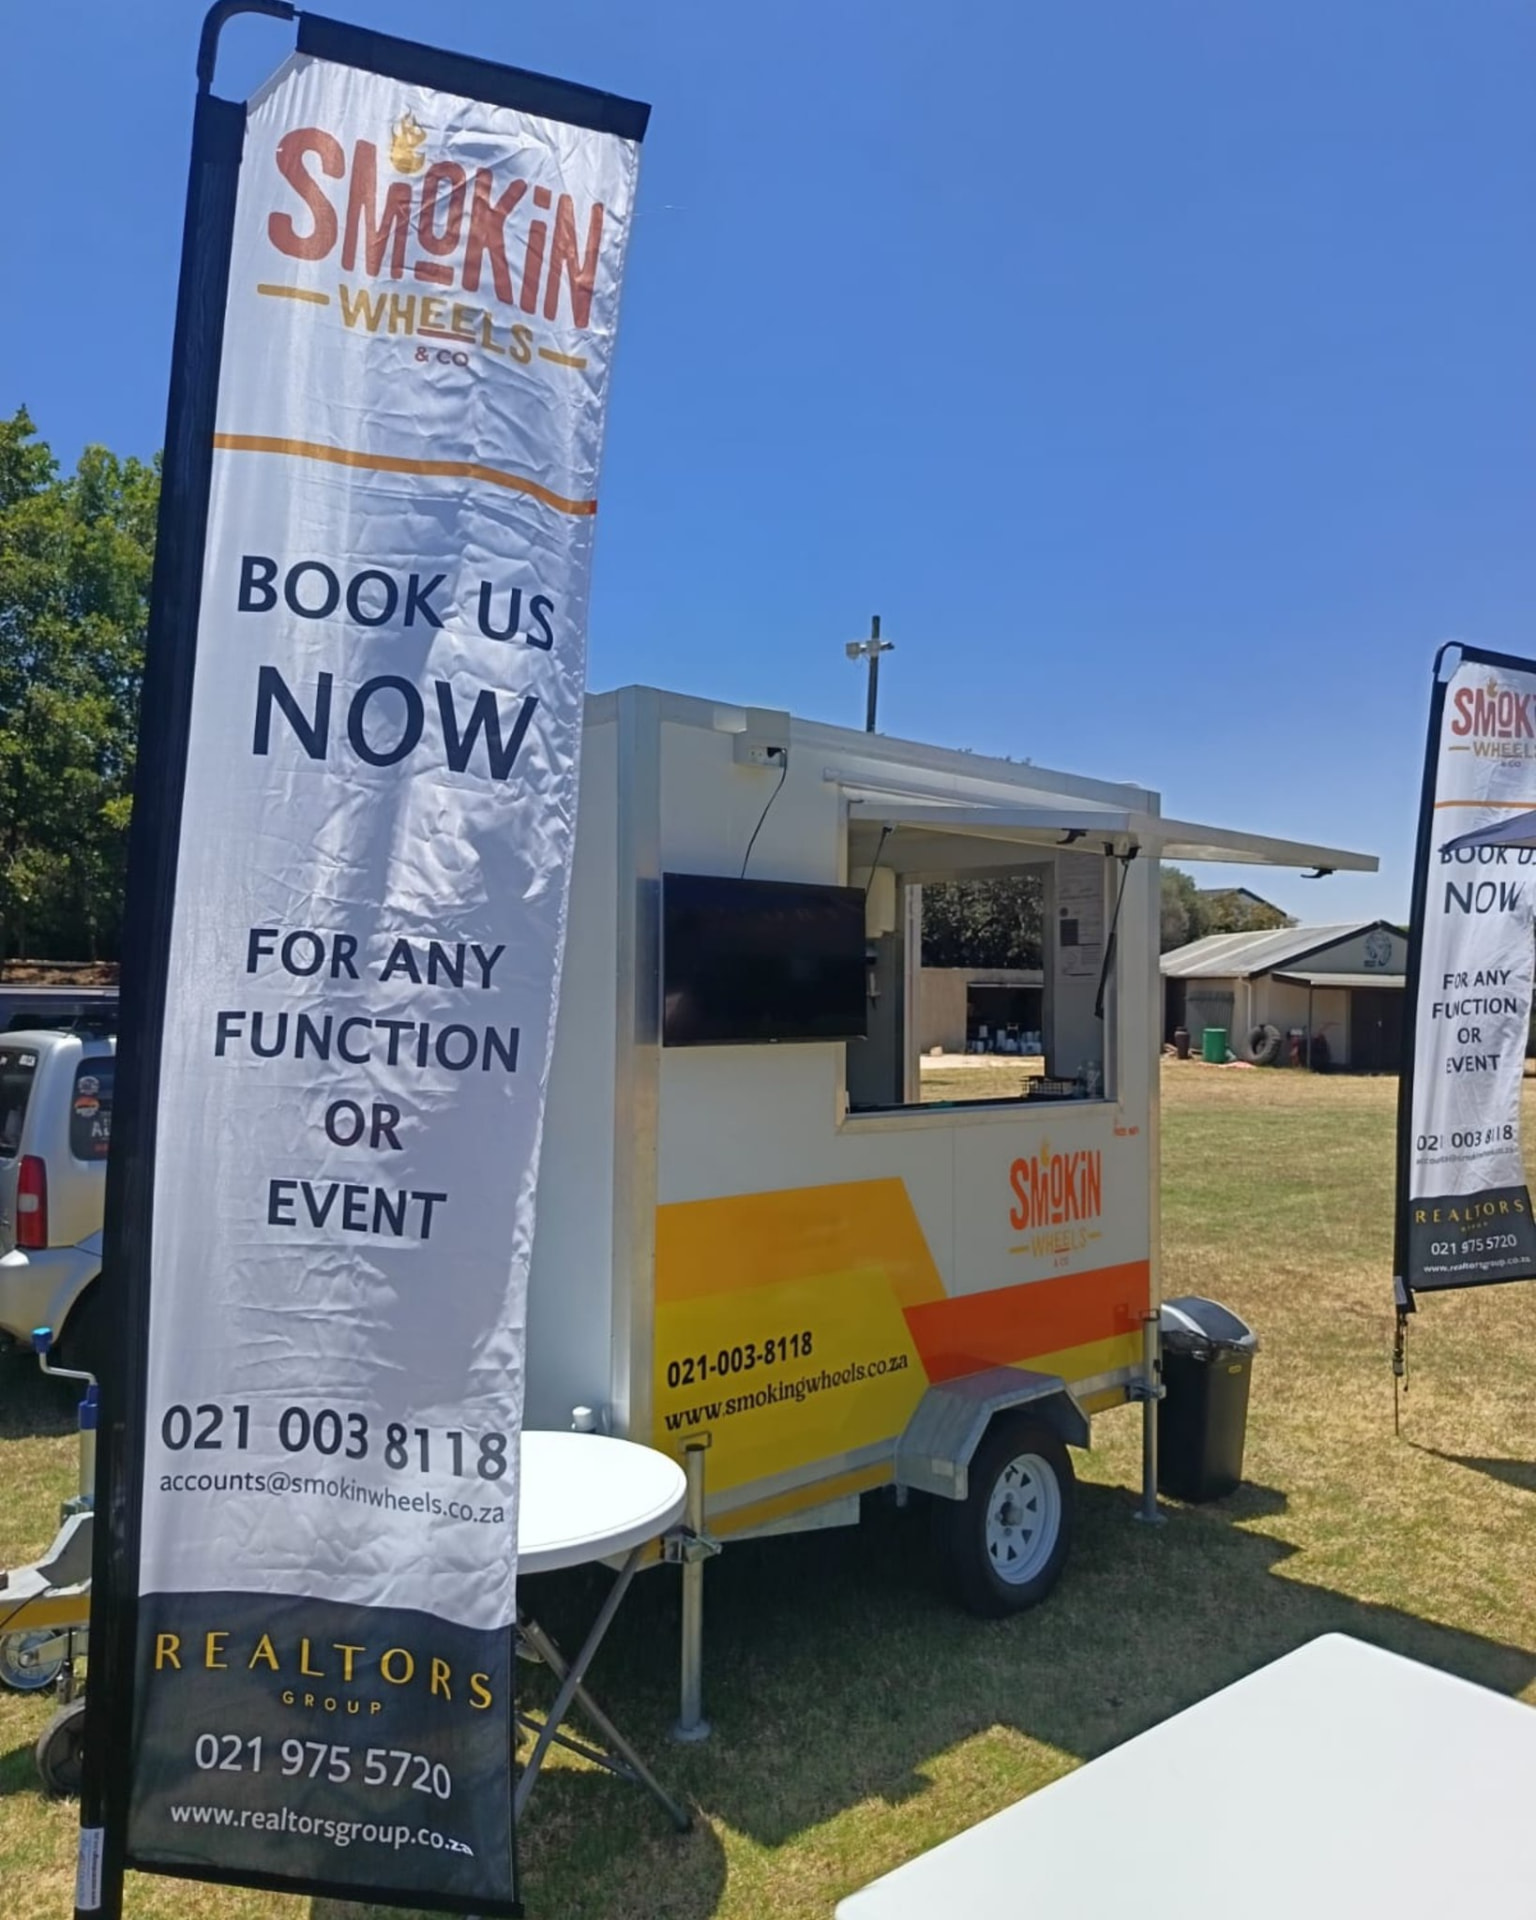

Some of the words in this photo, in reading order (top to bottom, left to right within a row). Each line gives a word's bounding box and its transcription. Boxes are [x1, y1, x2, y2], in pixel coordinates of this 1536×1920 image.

[339, 284, 533, 365] WHEELS
[415, 345, 429, 362] &
[436, 349, 469, 367] CO
[237, 555, 447, 629] BOOK
[477, 580, 555, 651] US
[252, 665, 539, 781] NOW
[1444, 881, 1526, 914] NOW
[246, 928, 360, 980] FOR
[378, 938, 506, 989] ANY
[1474, 969, 1511, 987] ANY
[214, 1011, 520, 1073] FUNCTION
[1457, 1027, 1482, 1044] OR
[1446, 1054, 1501, 1074] EVENT
[325, 1099, 403, 1150] OR
[1451, 1131, 1482, 1148] 003
[267, 1179, 448, 1239] EVENT
[1414, 1199, 1525, 1224] REALTORS
[1431, 1242, 1457, 1255] 021
[1486, 1234, 1518, 1250] 5720
[667, 1331, 813, 1389] 021-003-8118
[664, 1354, 908, 1431] www.smokingwheels.co.za
[161, 1403, 250, 1451] 021
[278, 1406, 369, 1460] 003
[384, 1422, 508, 1481] 8118
[160, 1471, 505, 1524] accounts@smokinwheels.co.za
[154, 1631, 493, 1709] REALTORS
[282, 1690, 382, 1715] GROUP
[195, 1733, 262, 1773] 021
[281, 1739, 351, 1783] 975
[364, 1749, 451, 1800] 5720
[171, 1806, 474, 1856] www.realtorsgroup.co.za
